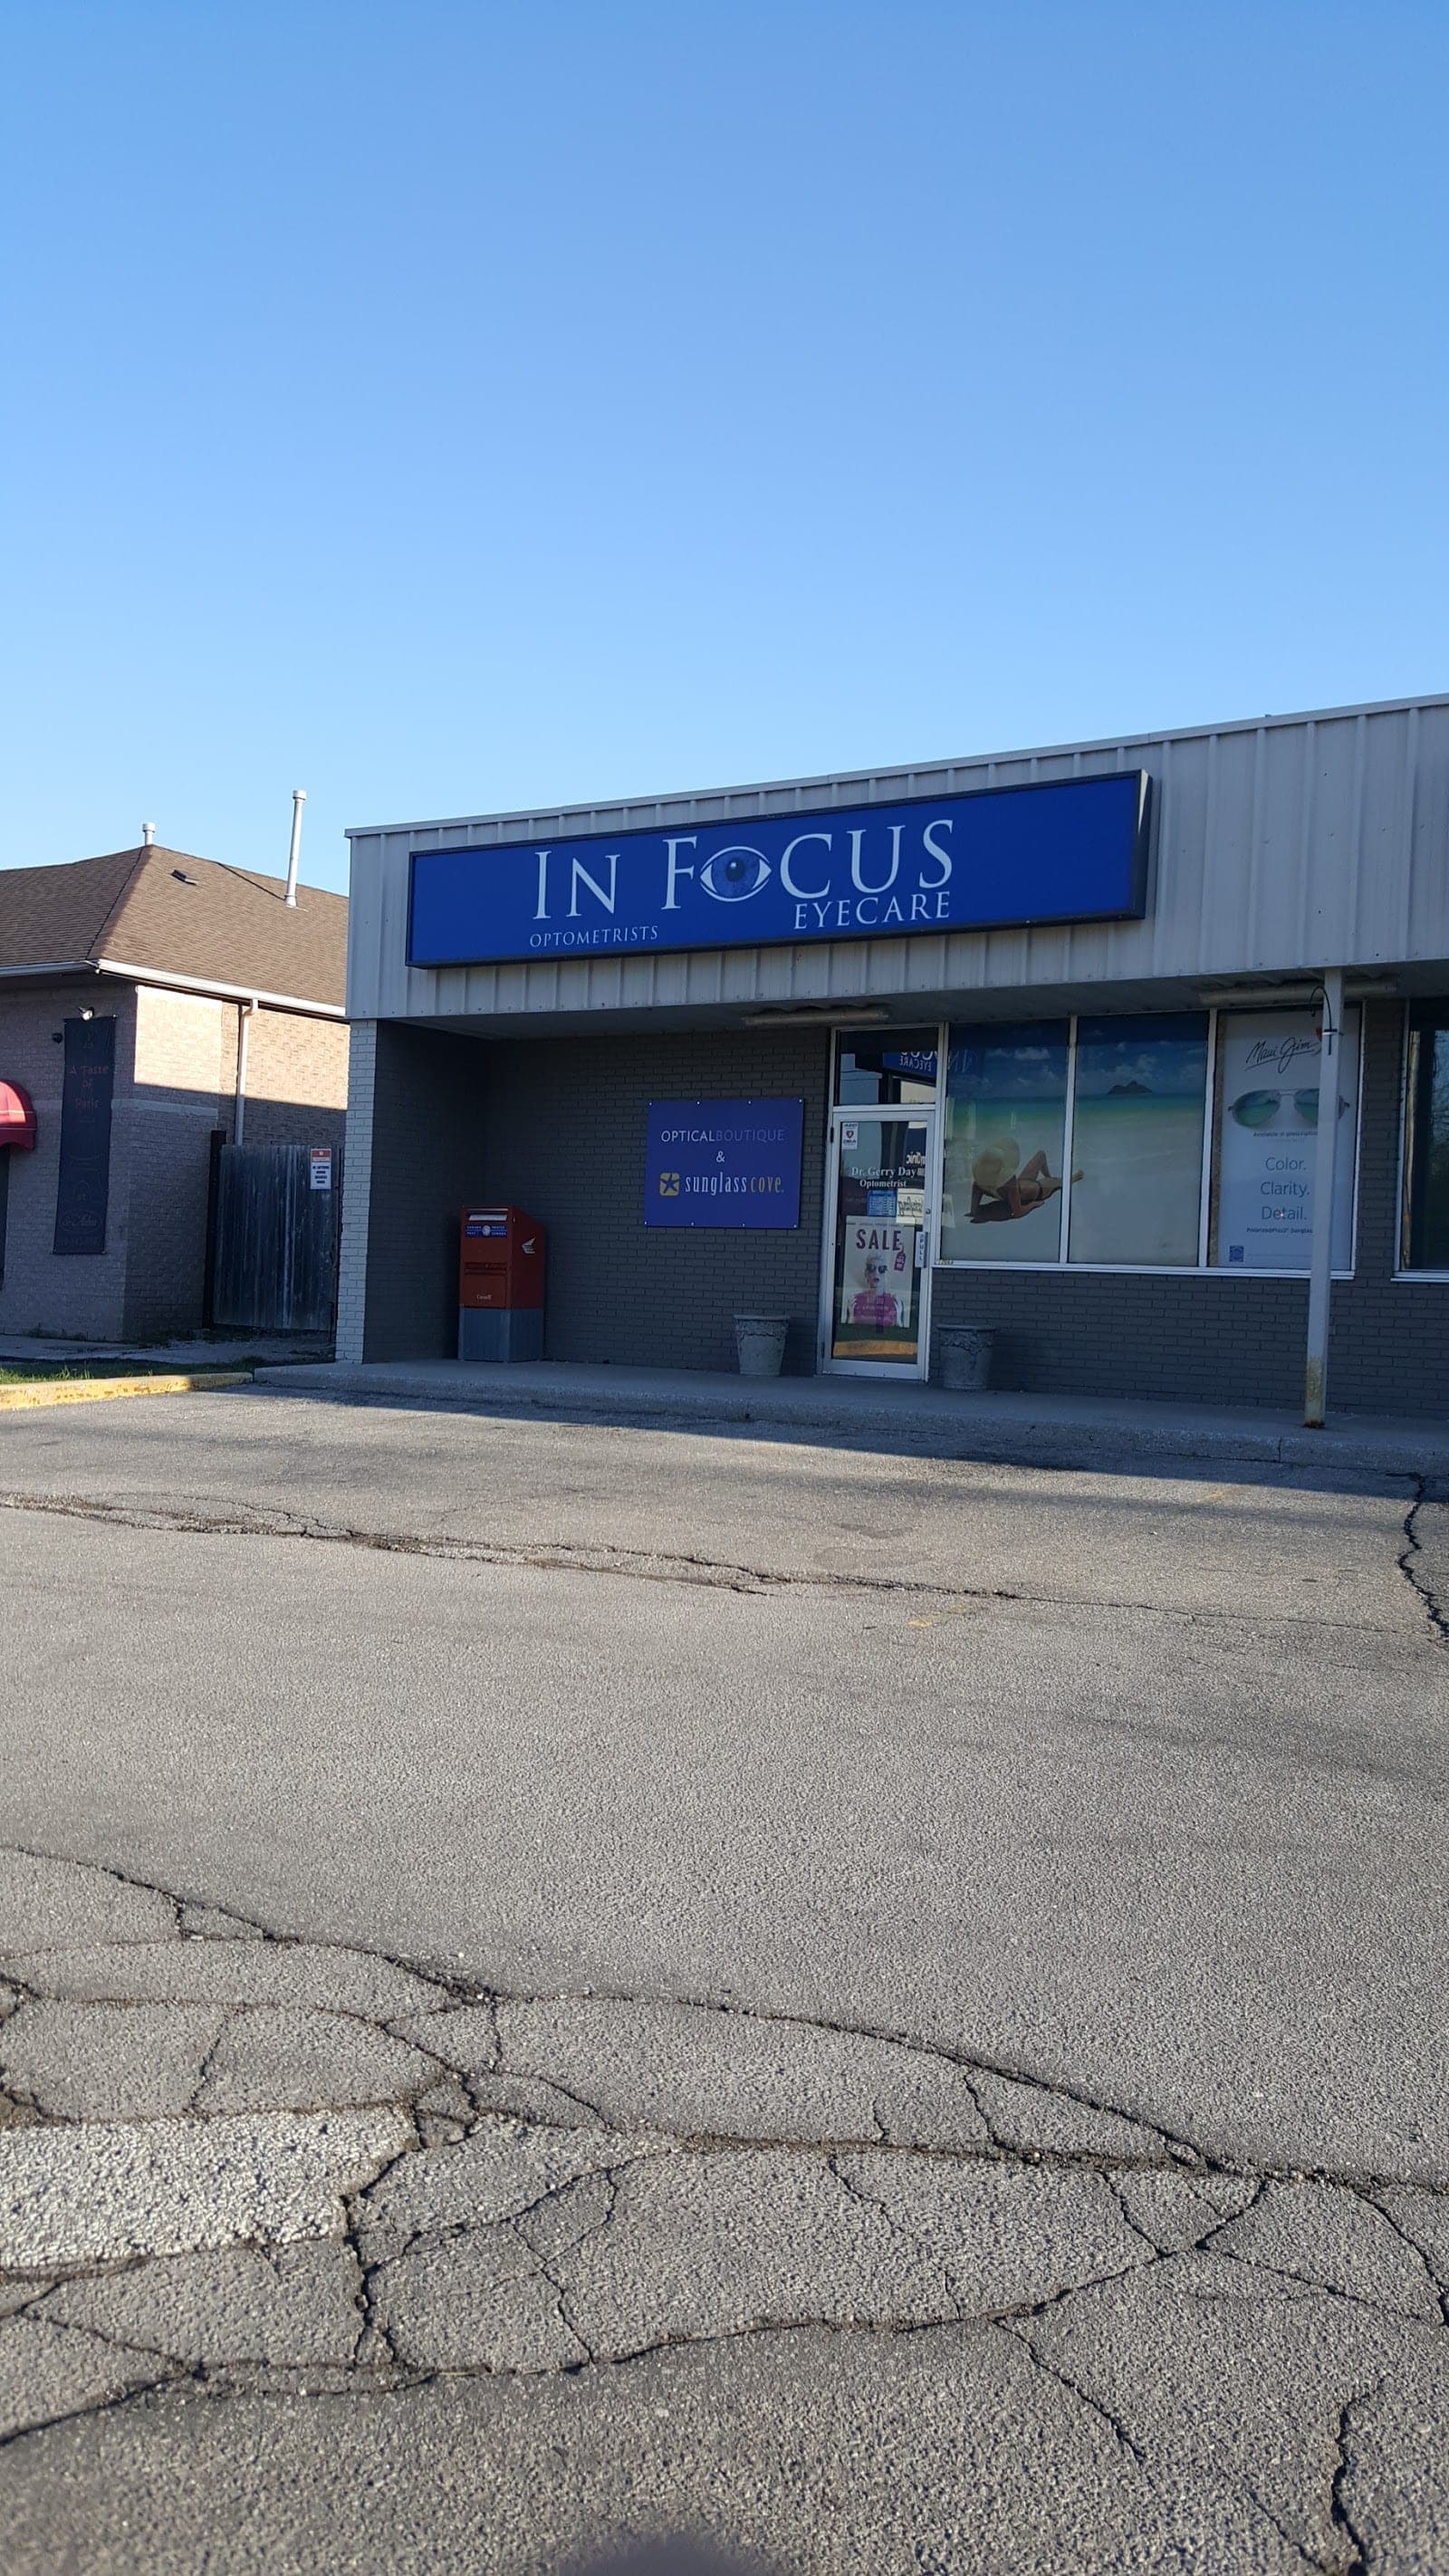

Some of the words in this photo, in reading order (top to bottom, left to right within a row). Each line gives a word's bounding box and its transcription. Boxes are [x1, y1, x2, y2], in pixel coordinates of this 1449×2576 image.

[533, 851, 620, 920] IN
[793, 890, 952, 930] EYECARE
[529, 924, 659, 948] OPTOMETRISTS
[715, 1150, 725, 1163] &
[1264, 1157, 1307, 1171] Color.
[850, 1167, 865, 1177] Dr.
[897, 1167, 917, 1179] Day
[859, 1179, 907, 1189] Optometrist
[1260, 1181, 1310, 1197] Clarity.
[1261, 1206, 1308, 1220] Detail.
[856, 1228, 902, 1251] SALE
